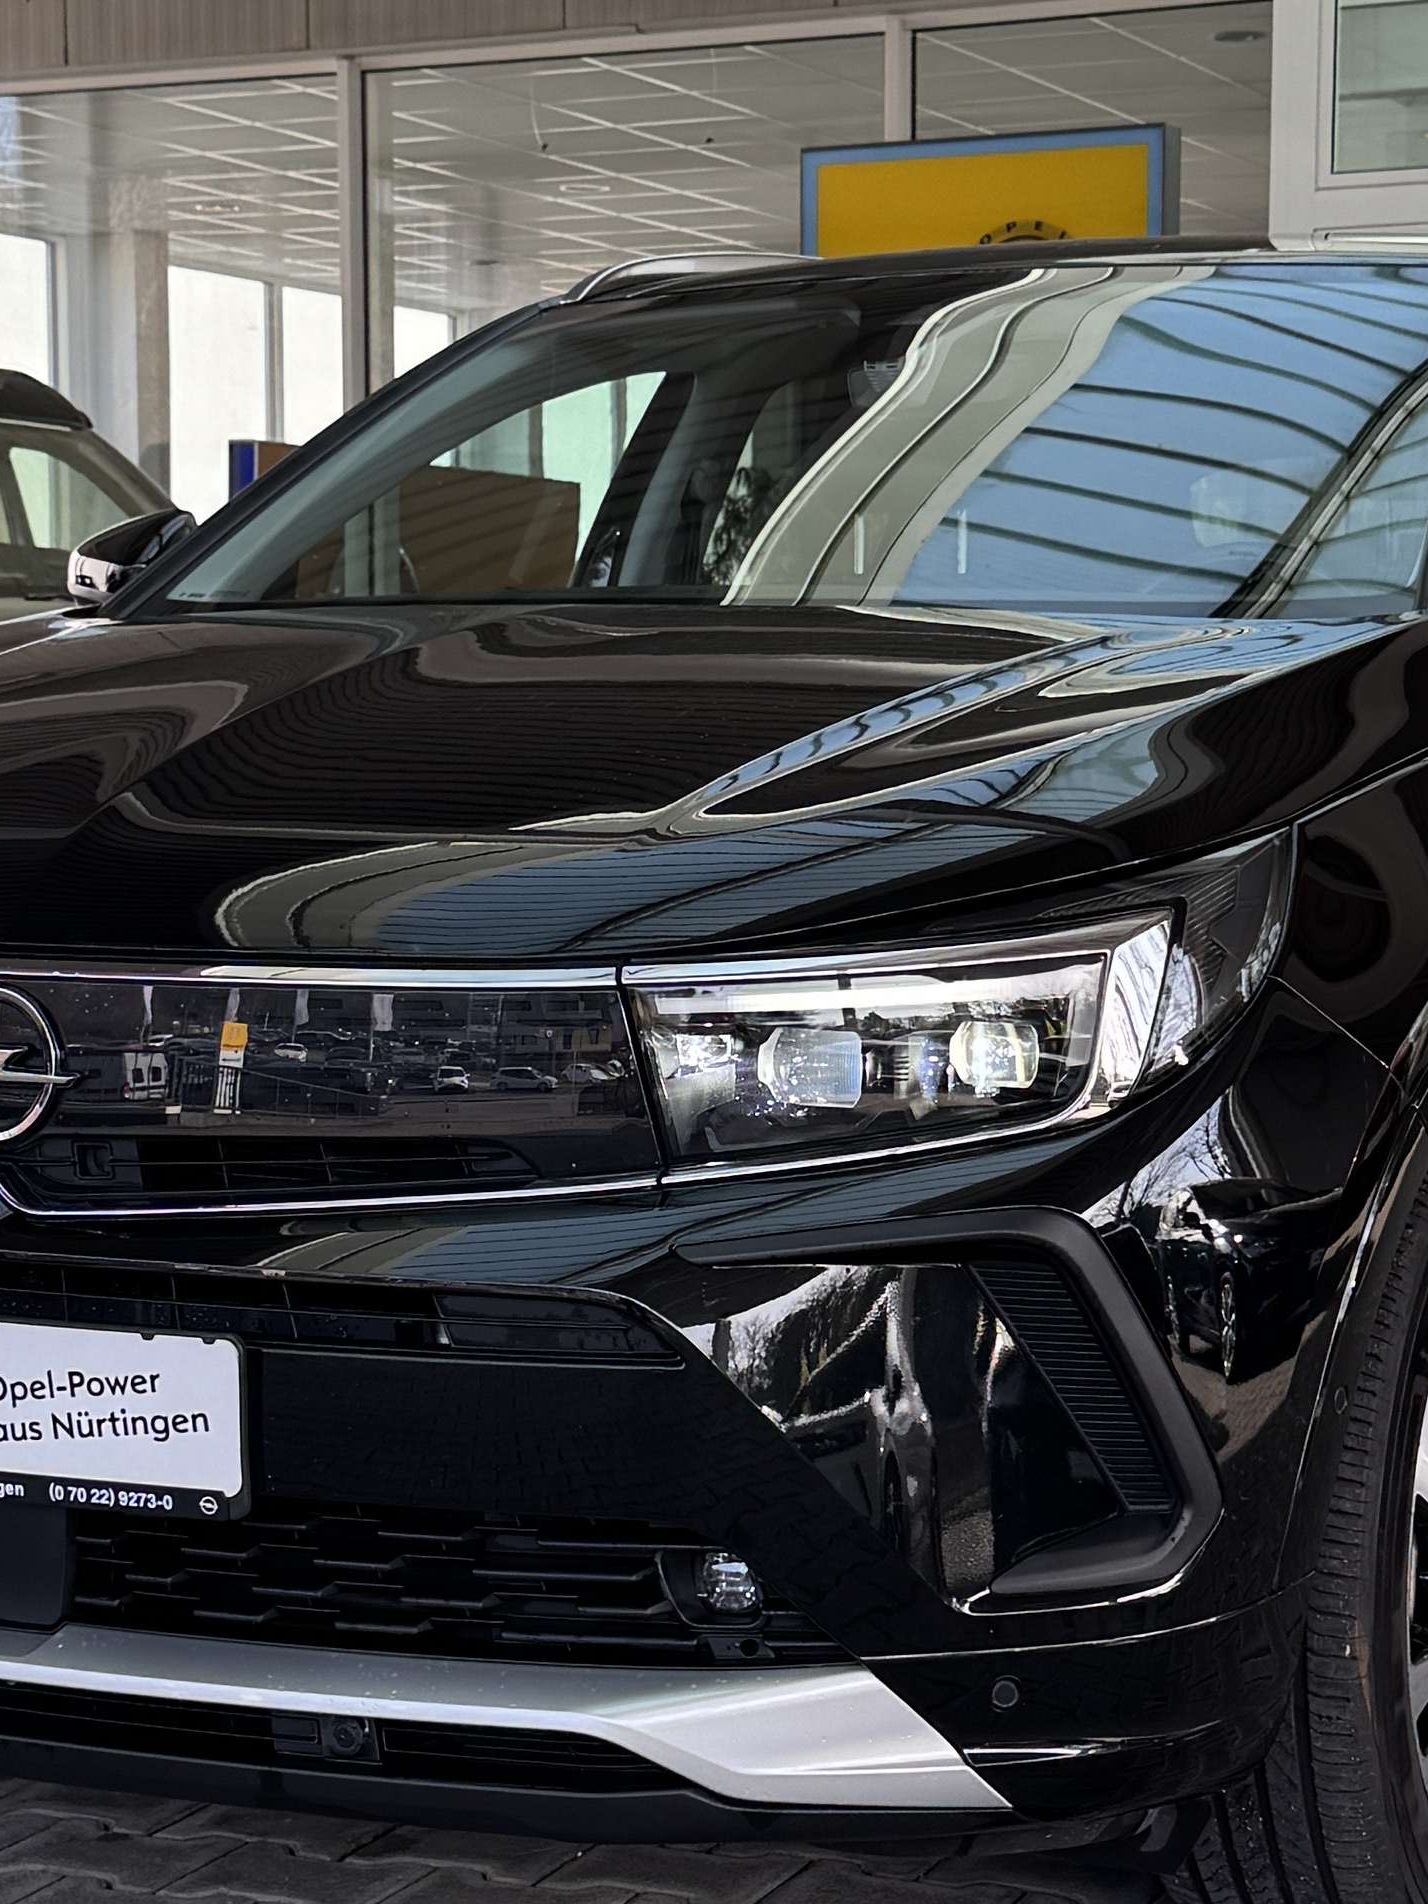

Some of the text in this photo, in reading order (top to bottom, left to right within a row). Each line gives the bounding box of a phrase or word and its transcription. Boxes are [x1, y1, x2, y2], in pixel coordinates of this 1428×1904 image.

[51, 1408, 210, 1442] Nürtingen
[67, 1486, 87, 1503] 70
[90, 1486, 115, 1507] 22)
[119, 1490, 173, 1510] 9273-0
